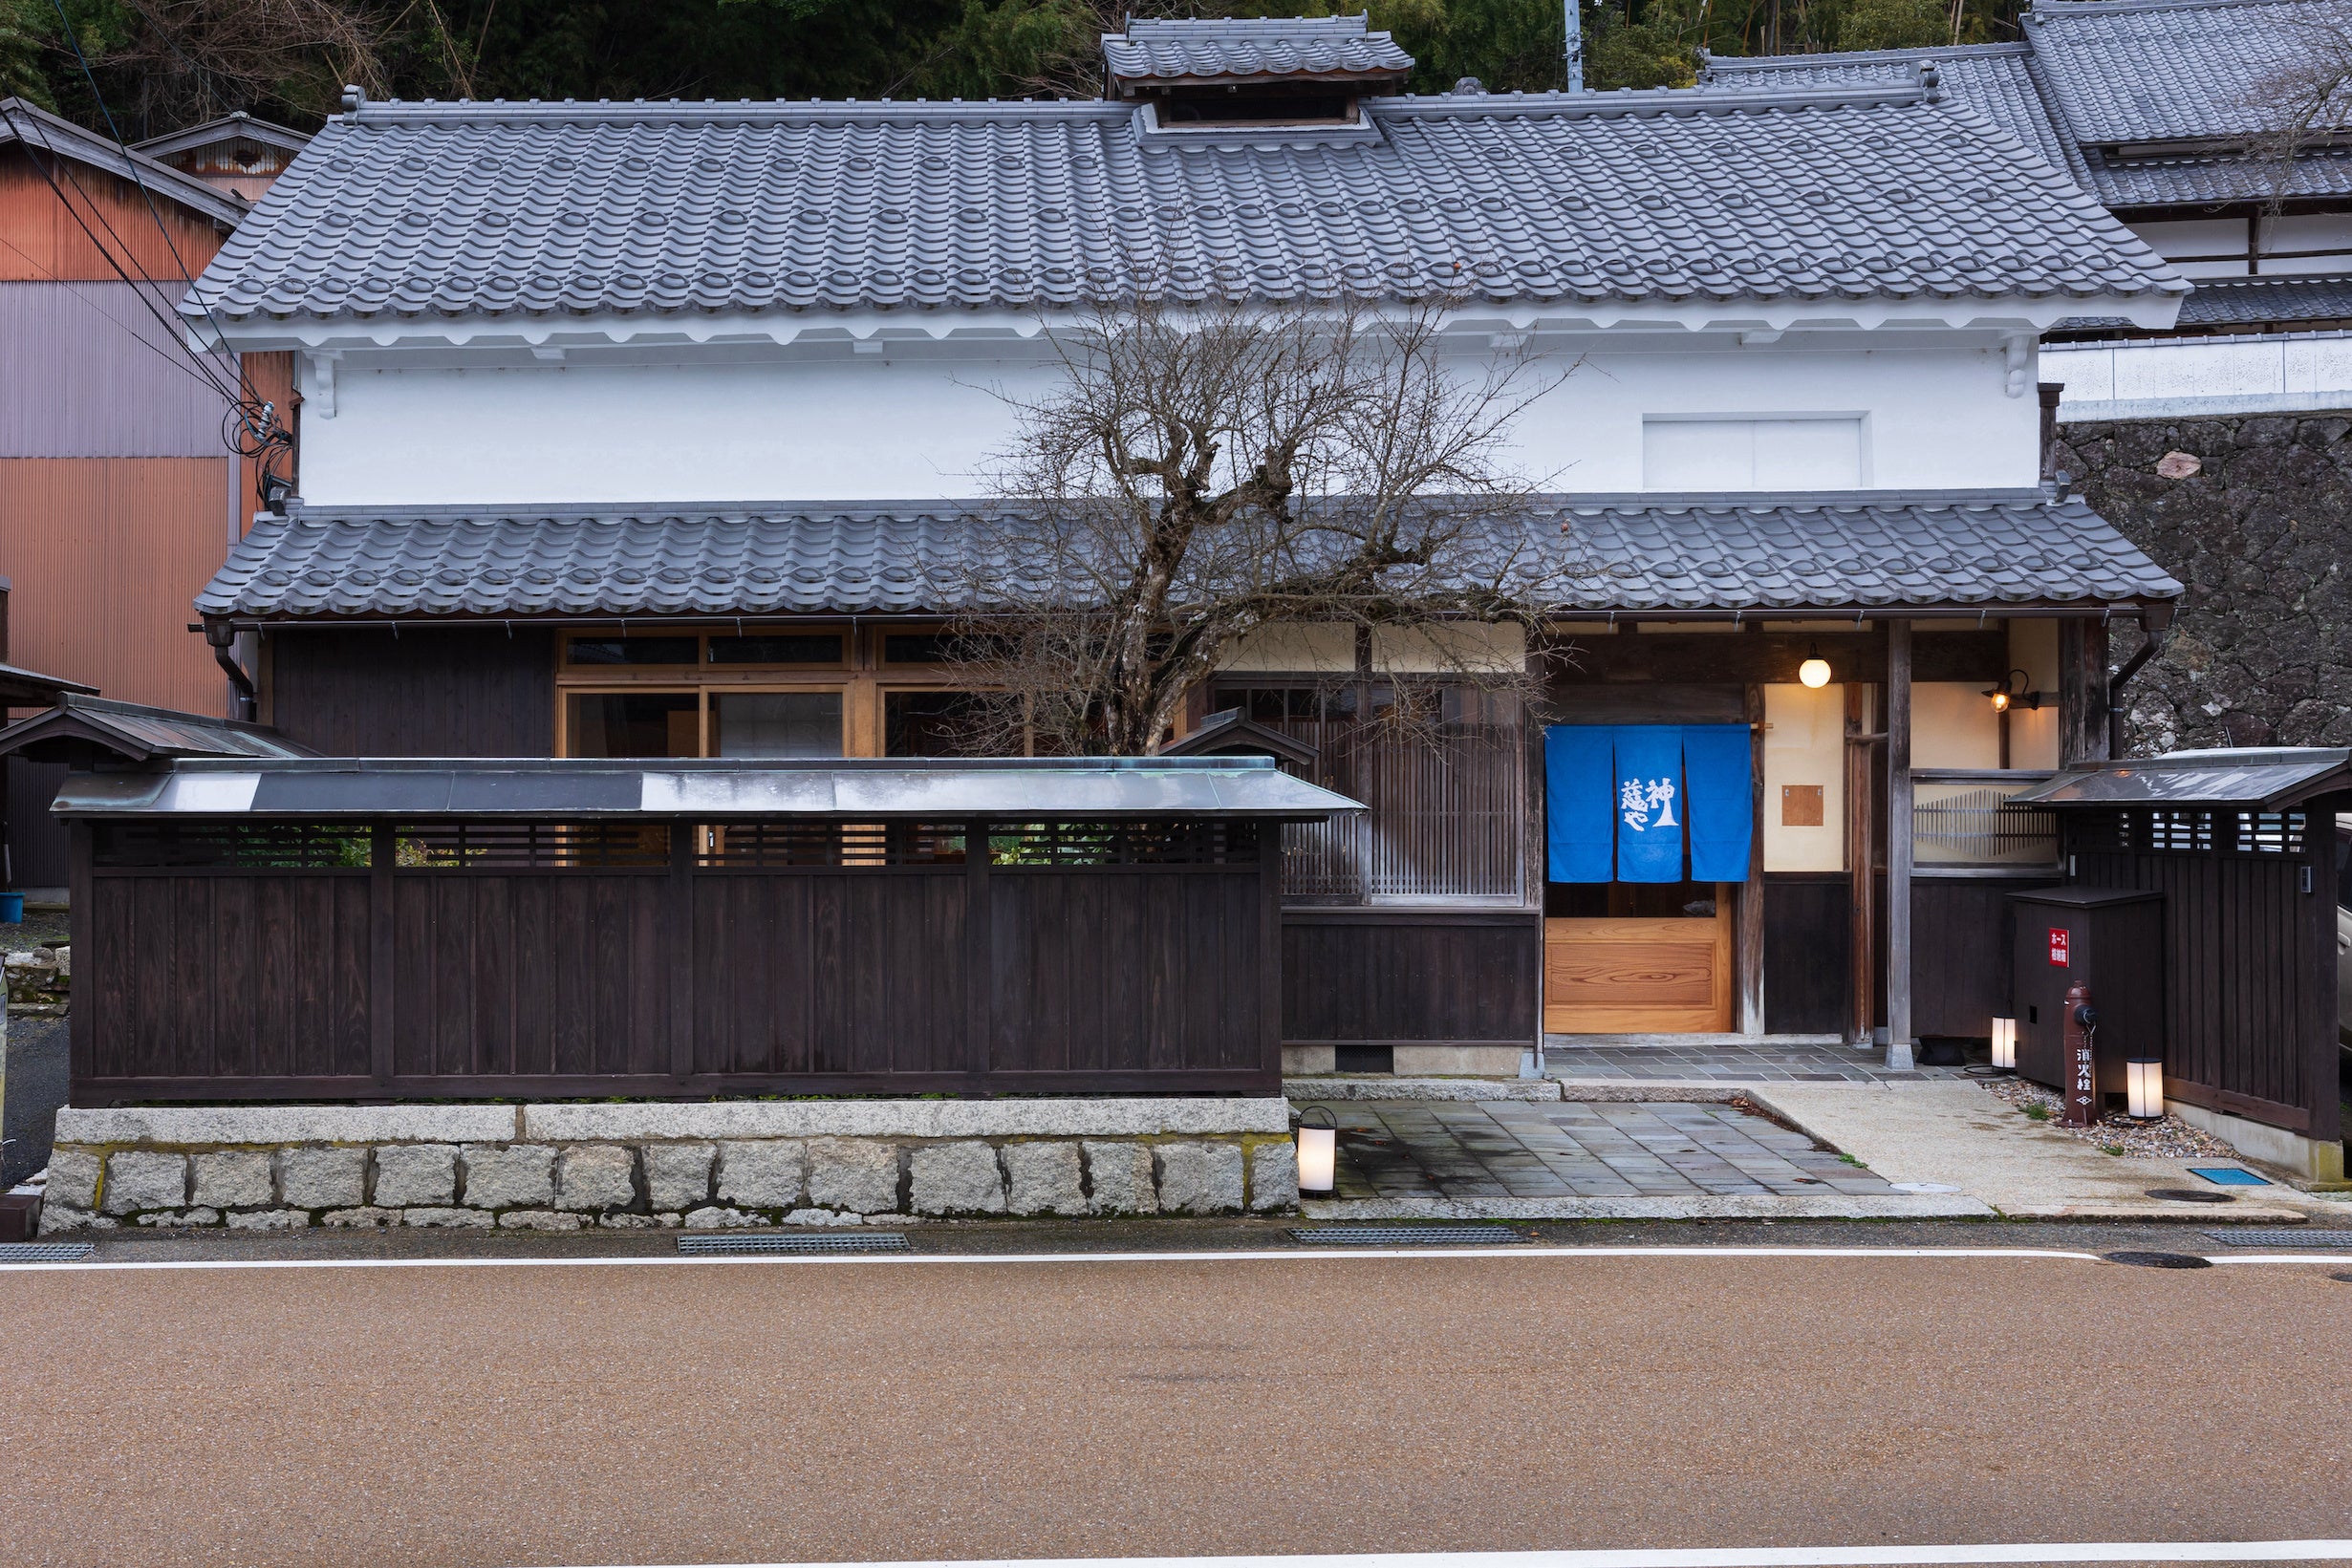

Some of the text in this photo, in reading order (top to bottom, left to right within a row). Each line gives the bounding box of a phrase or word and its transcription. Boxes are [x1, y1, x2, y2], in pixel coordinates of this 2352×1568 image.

[2051, 933, 2066, 946] ホース
[2077, 1049, 2091, 1090] 消火栓
